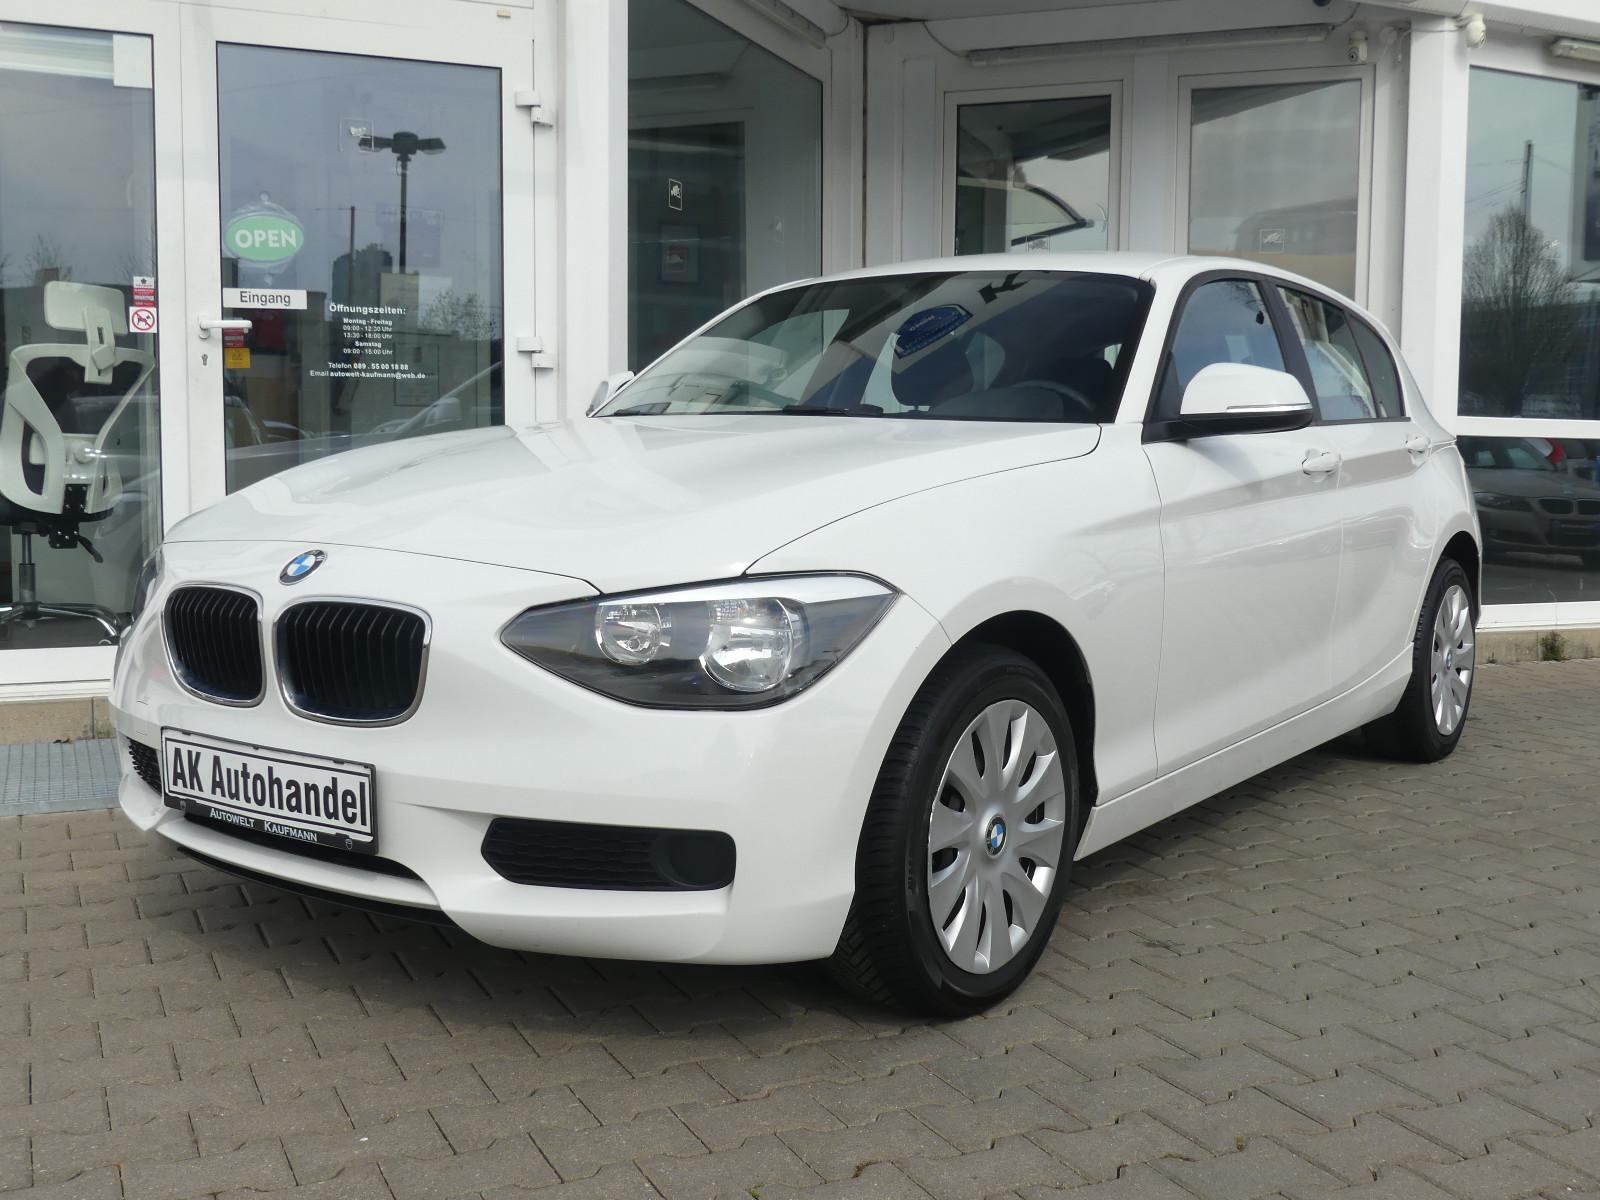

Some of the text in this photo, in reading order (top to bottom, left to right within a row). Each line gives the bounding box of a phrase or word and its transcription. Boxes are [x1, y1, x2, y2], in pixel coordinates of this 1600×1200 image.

[234, 229, 297, 248] OPEN
[239, 290, 291, 307] Eingang
[329, 302, 406, 315] Öffnungszeiten:
[343, 317, 366, 325] Montag
[370, 318, 393, 326] Freitag
[354, 340, 382, 348] Samstag
[329, 371, 426, 379] autowelt-kaufmann@web.de
[172, 747, 368, 827] AK Autohandel
[209, 807, 318, 843] AUTOWELT KAUFMANN
